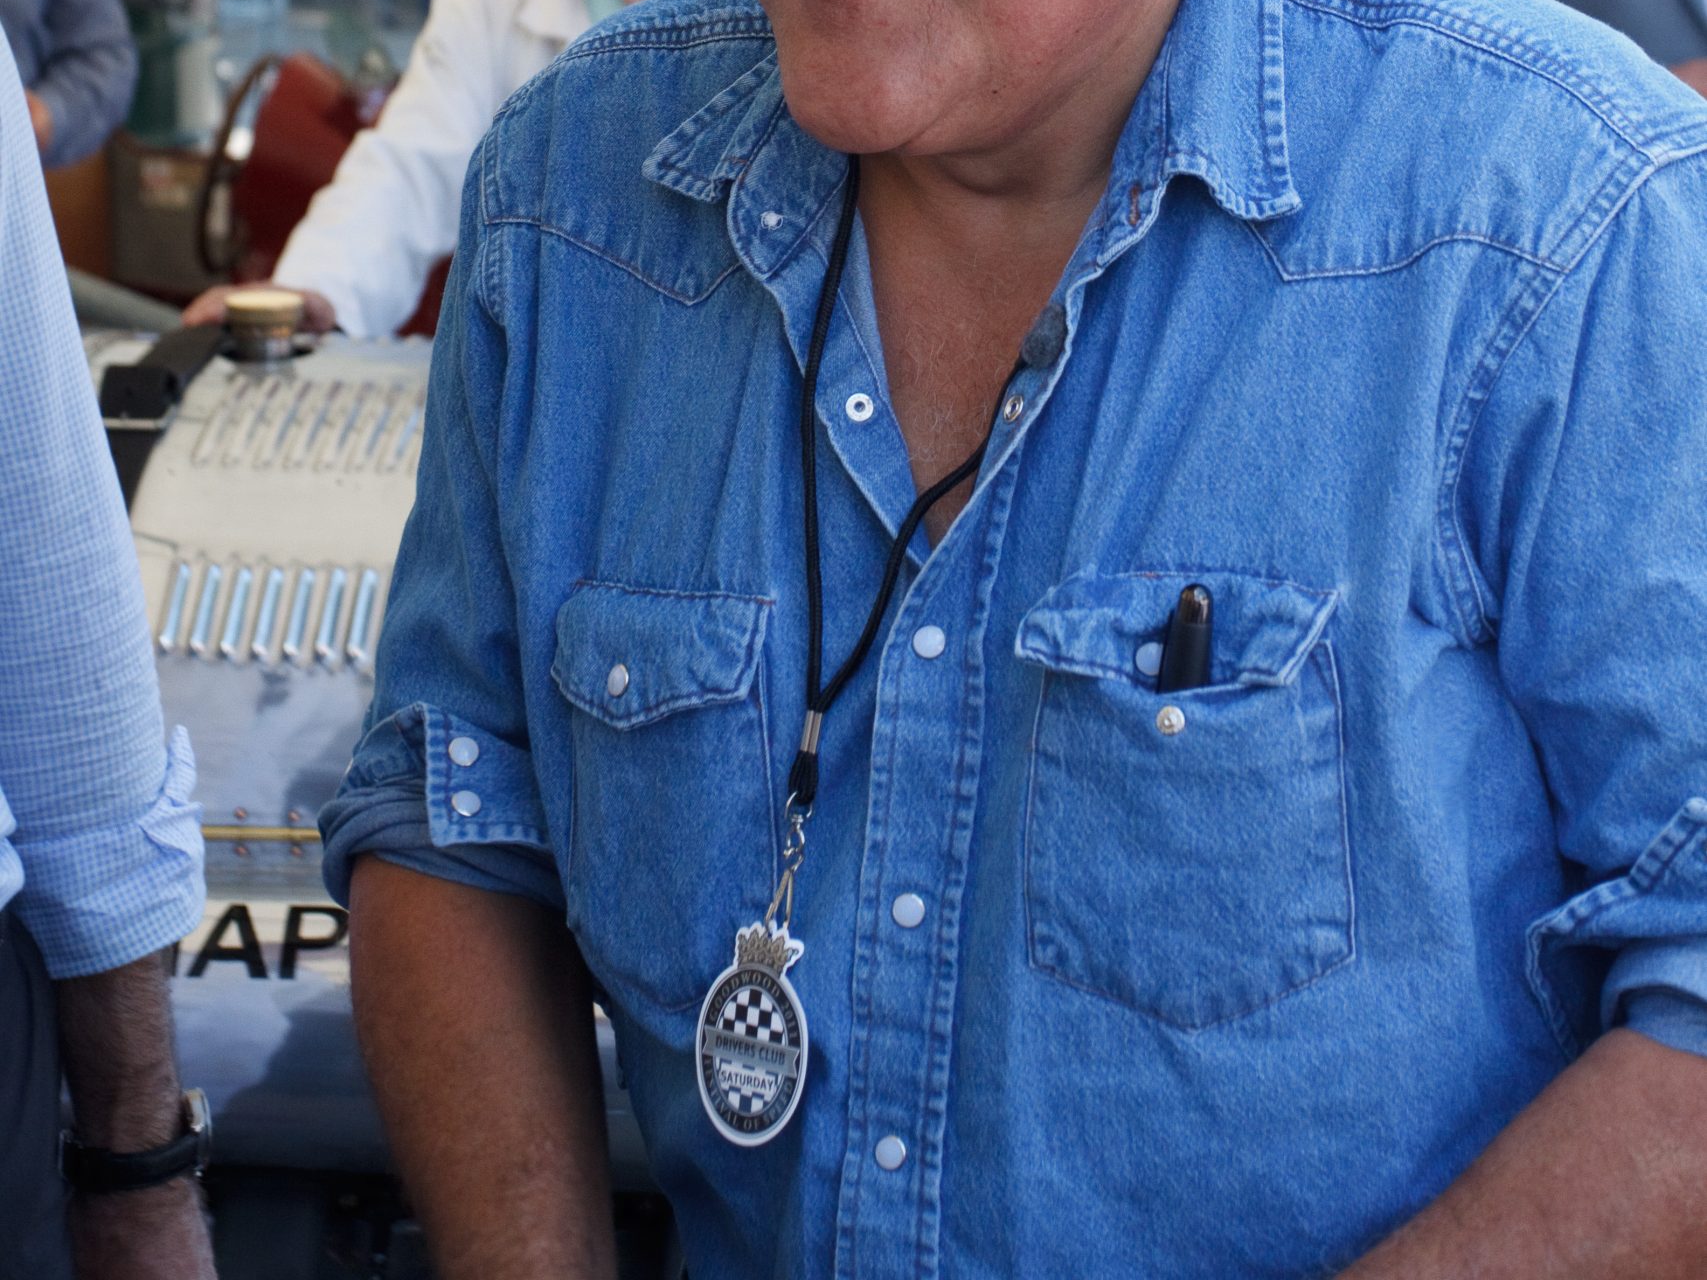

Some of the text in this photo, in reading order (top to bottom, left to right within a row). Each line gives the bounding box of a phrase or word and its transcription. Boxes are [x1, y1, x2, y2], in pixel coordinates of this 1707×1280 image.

[172, 903, 350, 980] AP
[709, 971, 780, 1022] GOODWOOD
[715, 1034, 786, 1066] DRIVERS CLUB
[720, 1070, 774, 1092] SATURDAY
